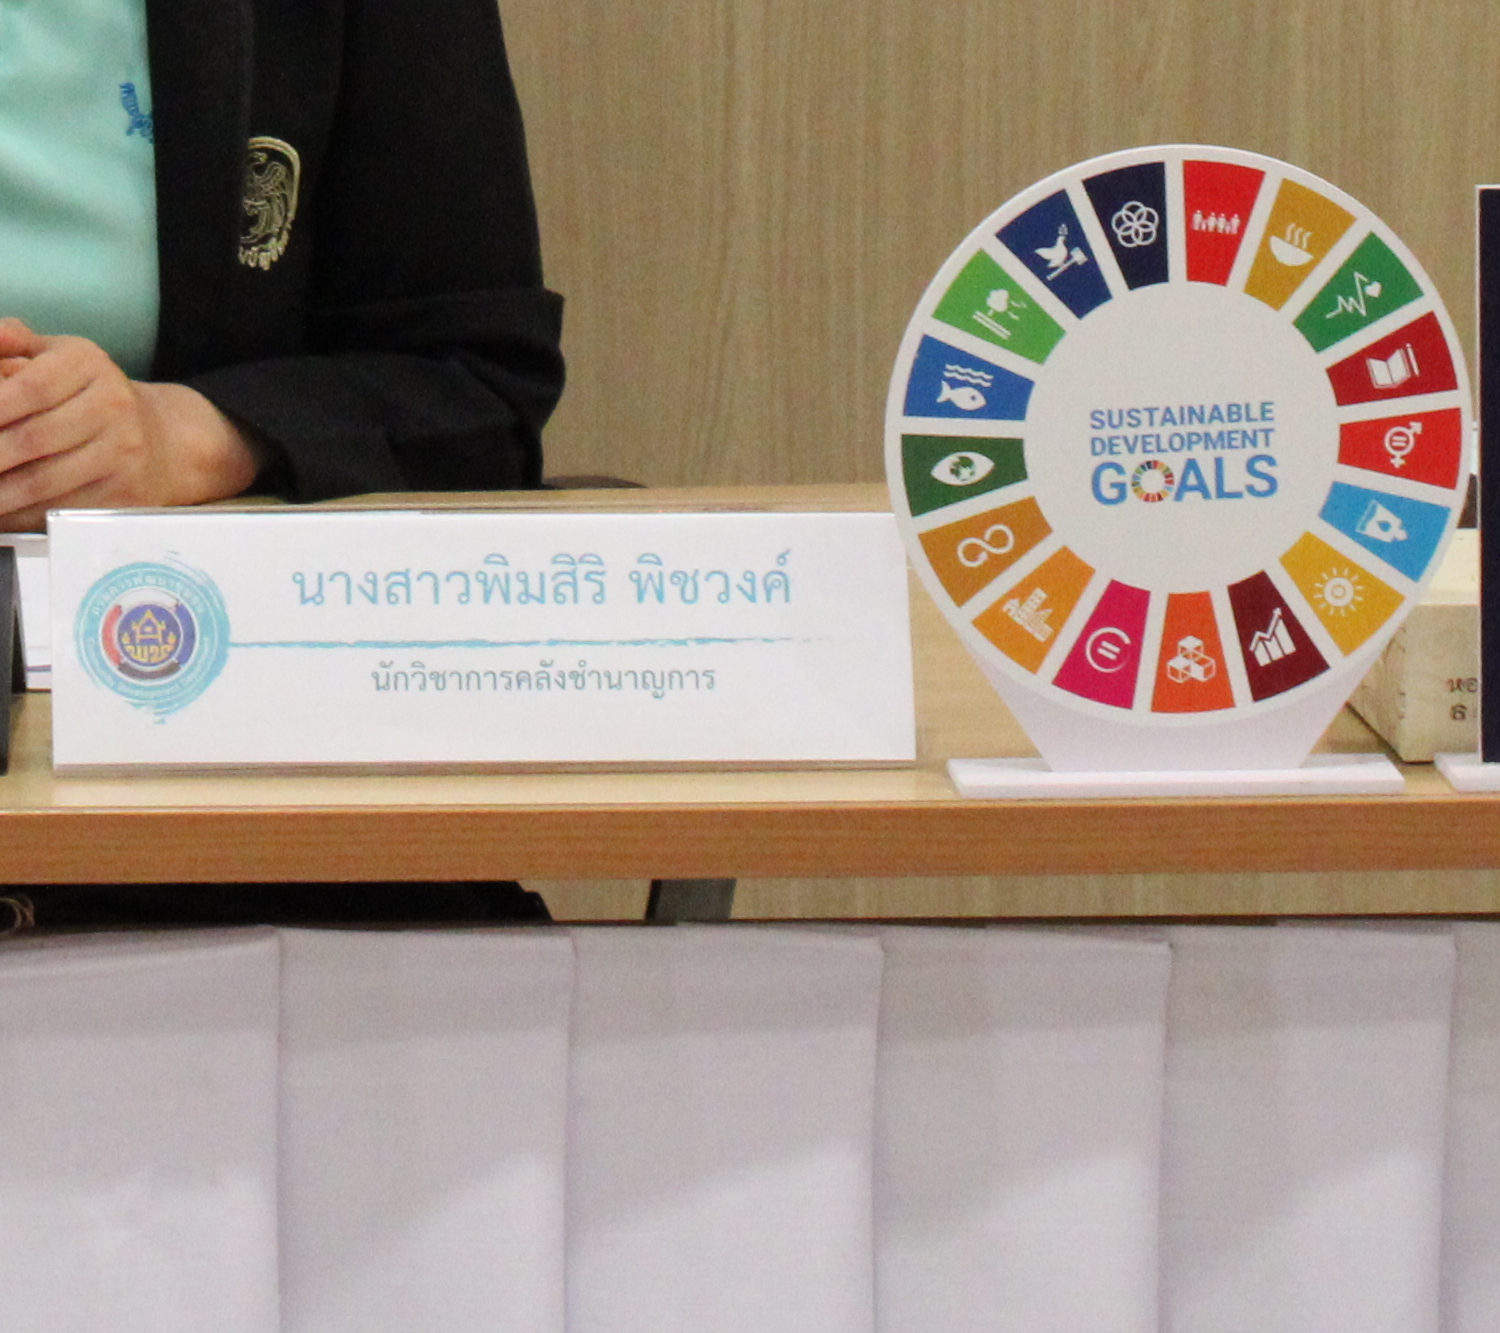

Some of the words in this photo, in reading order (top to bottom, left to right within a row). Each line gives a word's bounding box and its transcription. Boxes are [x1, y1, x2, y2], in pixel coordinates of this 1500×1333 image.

[1089, 401, 1276, 430] SUSTAINABLE
[1090, 428, 1275, 457] DEVELOPMENT
[1090, 454, 1279, 507] GOALS
[291, 551, 608, 606] นางสาวพิมสิริ
[628, 548, 792, 605] พิชวงค์
[371, 660, 716, 700] นักวิชาการคลังชำนาญการ
